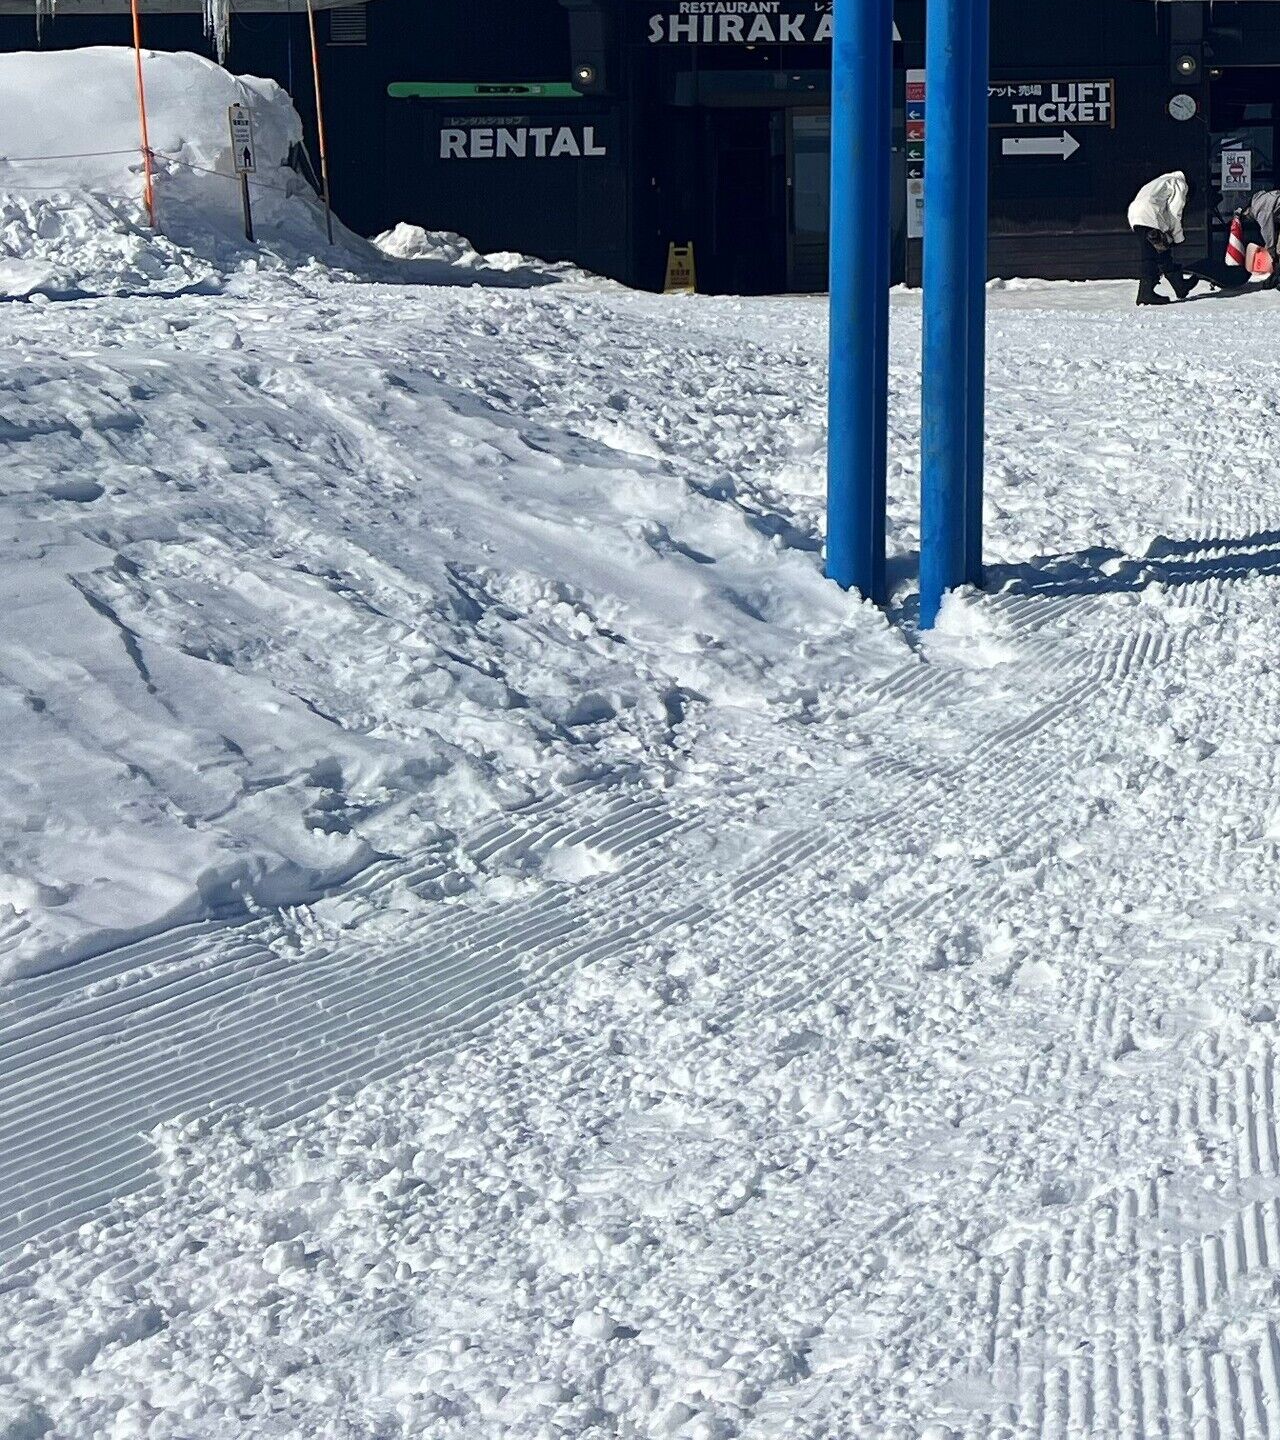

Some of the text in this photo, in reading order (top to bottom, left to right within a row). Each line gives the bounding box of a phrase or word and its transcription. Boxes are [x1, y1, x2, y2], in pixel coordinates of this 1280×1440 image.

[679, 1, 780, 14] RESTAURANT
[1051, 83, 1110, 102] LIFT
[1012, 103, 1111, 123] TICKET
[440, 127, 607, 158] RENTAL
[1226, 175, 1247, 183] EXIT
